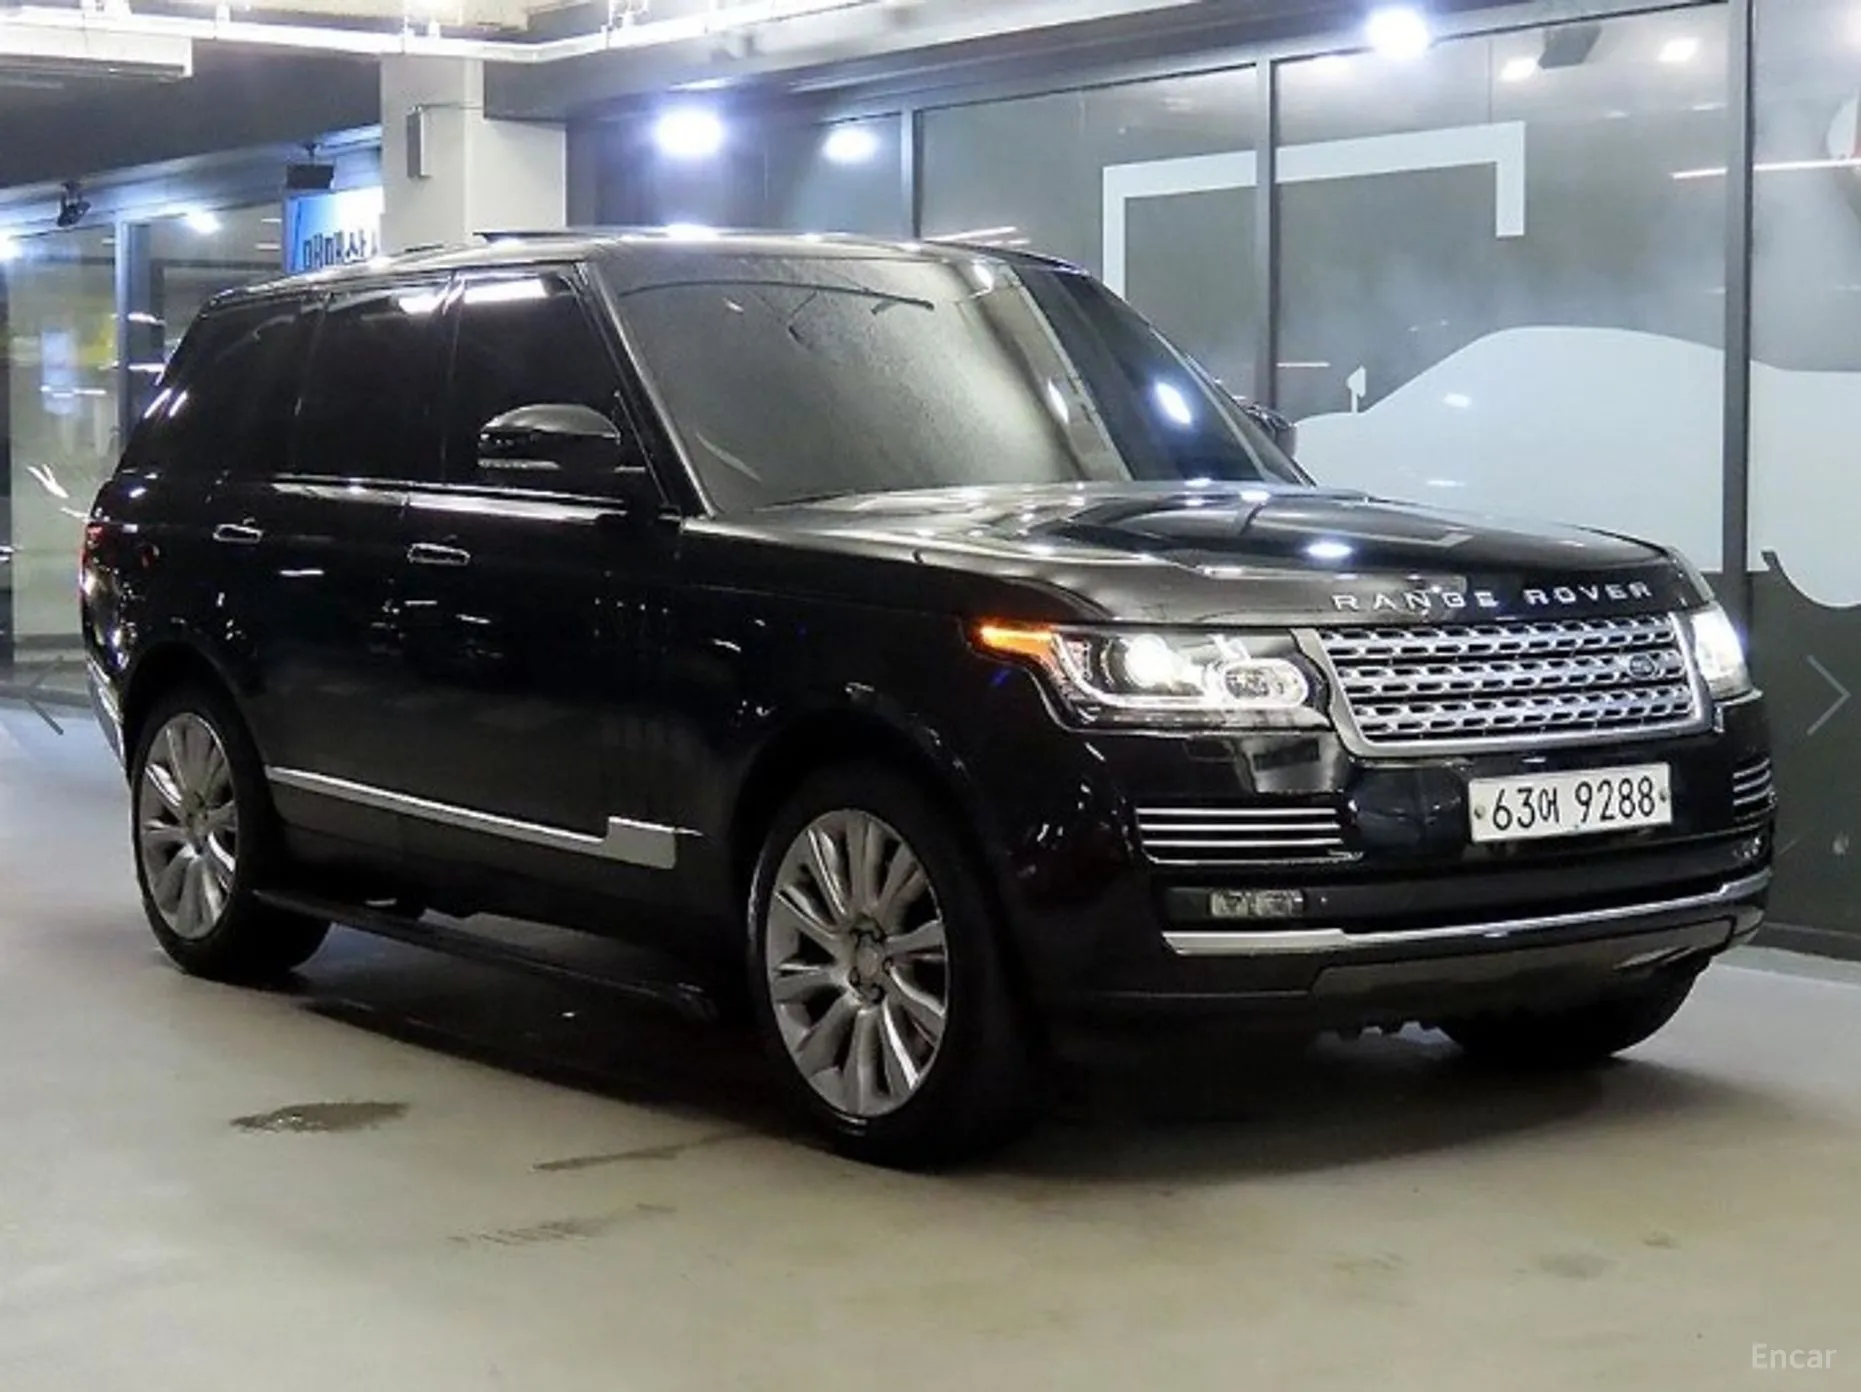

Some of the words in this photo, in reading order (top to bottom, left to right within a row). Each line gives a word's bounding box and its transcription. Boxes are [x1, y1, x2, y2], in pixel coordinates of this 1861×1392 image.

[1332, 591, 1500, 611] RANGE
[1523, 582, 1653, 606] ROVER
[1493, 787, 1560, 831] 63어
[1574, 775, 1656, 823] 9288
